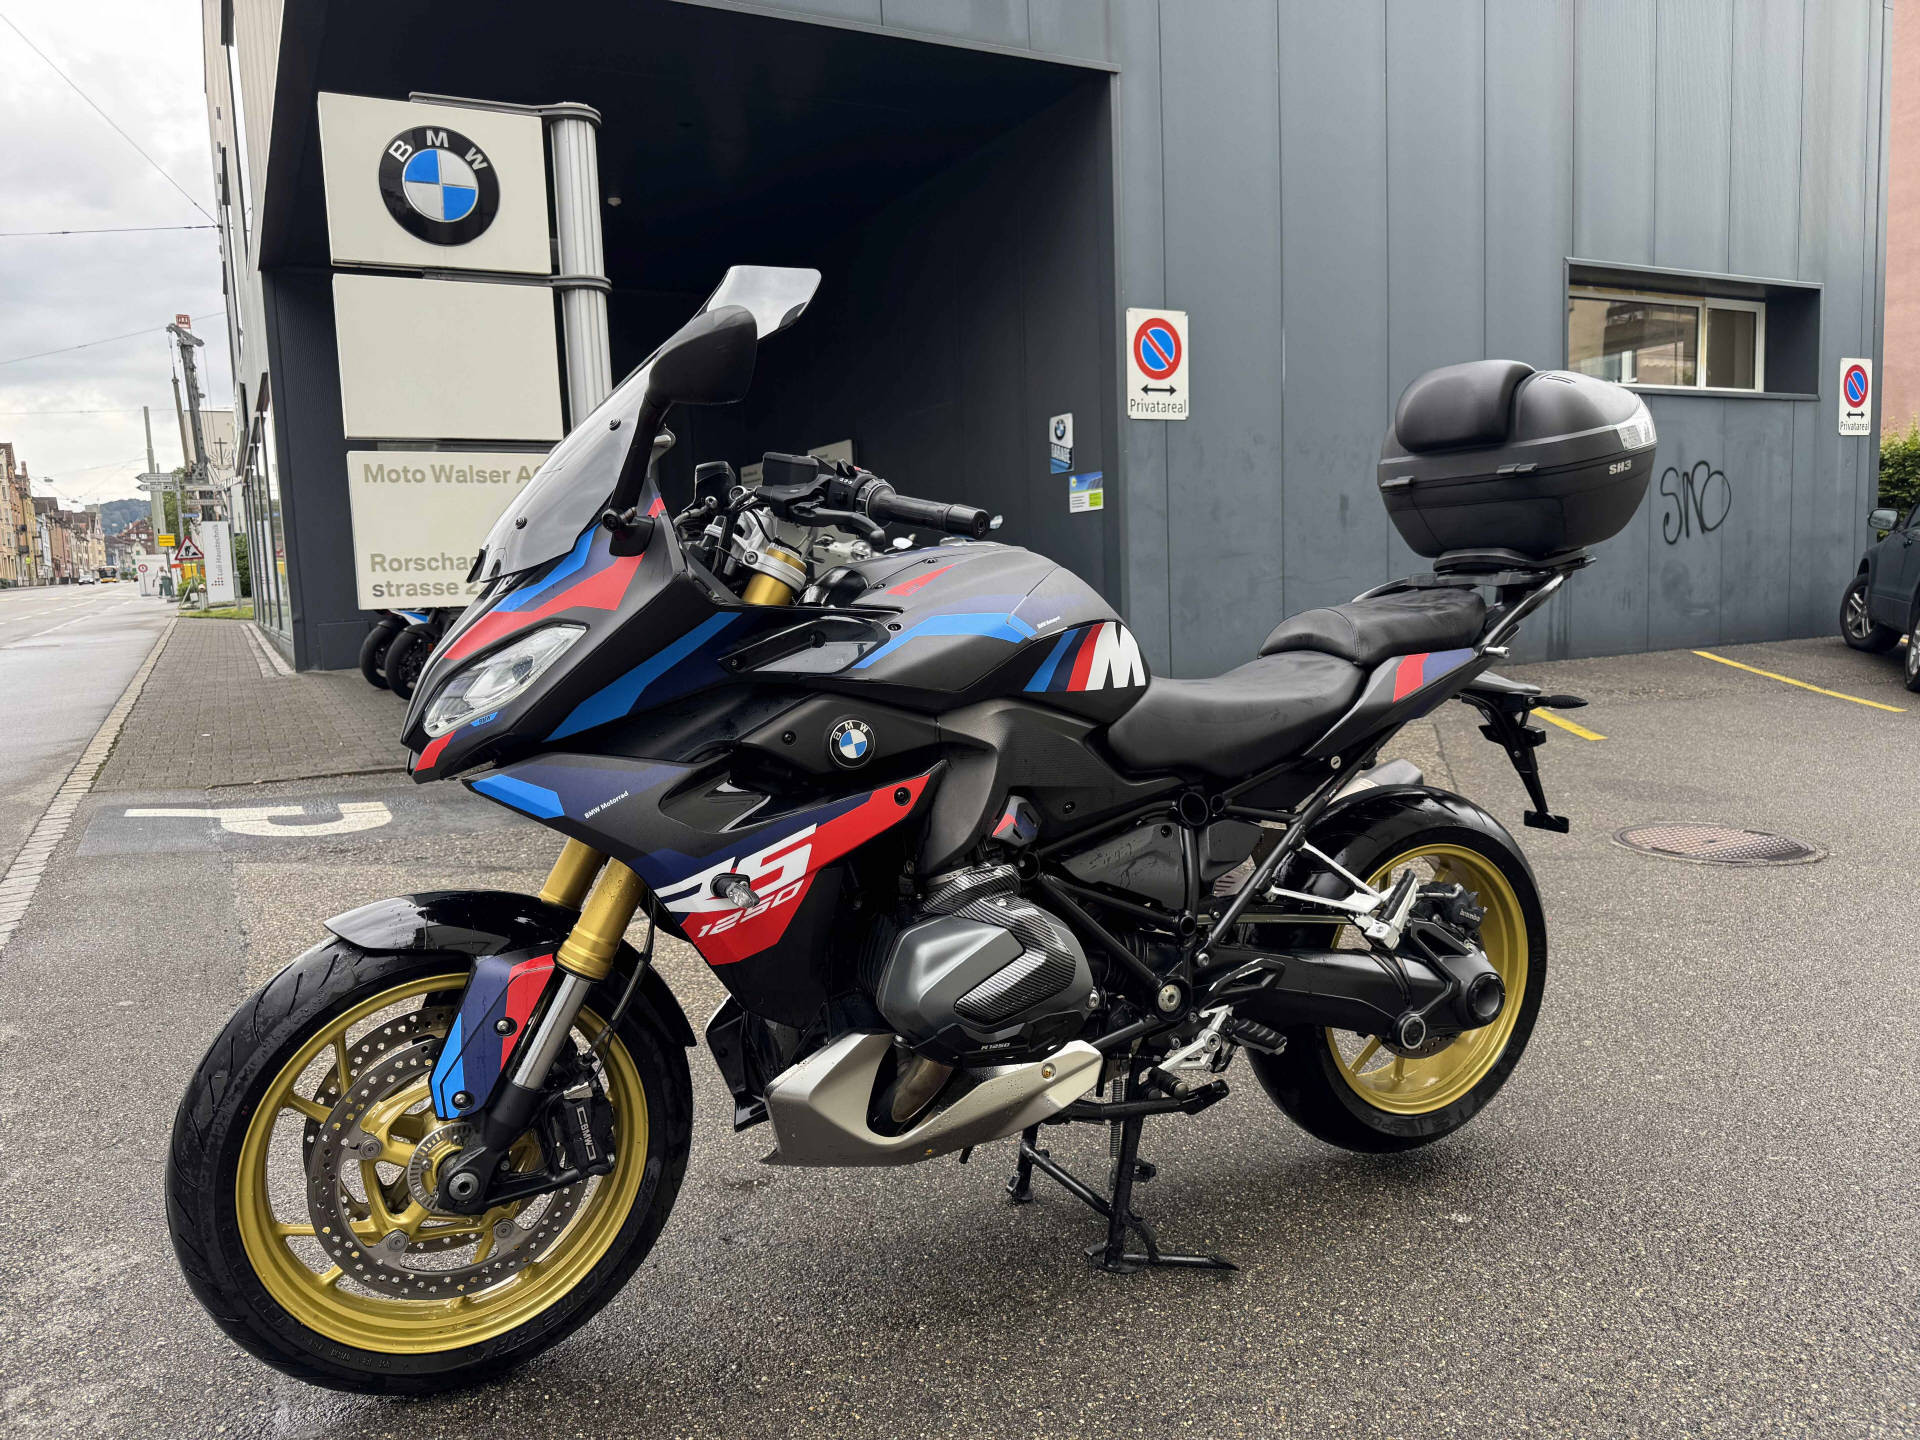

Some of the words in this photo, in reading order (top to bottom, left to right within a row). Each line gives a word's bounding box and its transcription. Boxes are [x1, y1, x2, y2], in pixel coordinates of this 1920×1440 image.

[388, 128, 488, 171] BMW
[1130, 398, 1187, 414] Privatareal
[1840, 420, 1870, 431] Privatareal
[363, 463, 426, 484] Moto
[430, 464, 511, 484] Walser
[1608, 459, 1632, 475] SH3
[372, 580, 459, 598] strasse
[1085, 621, 1146, 691] M
[833, 721, 869, 741] BMW
[584, 805, 601, 819] BMW
[600, 790, 629, 810] Motorrad
[697, 879, 805, 938] 1250
[580, 1123, 593, 1146] BMW
